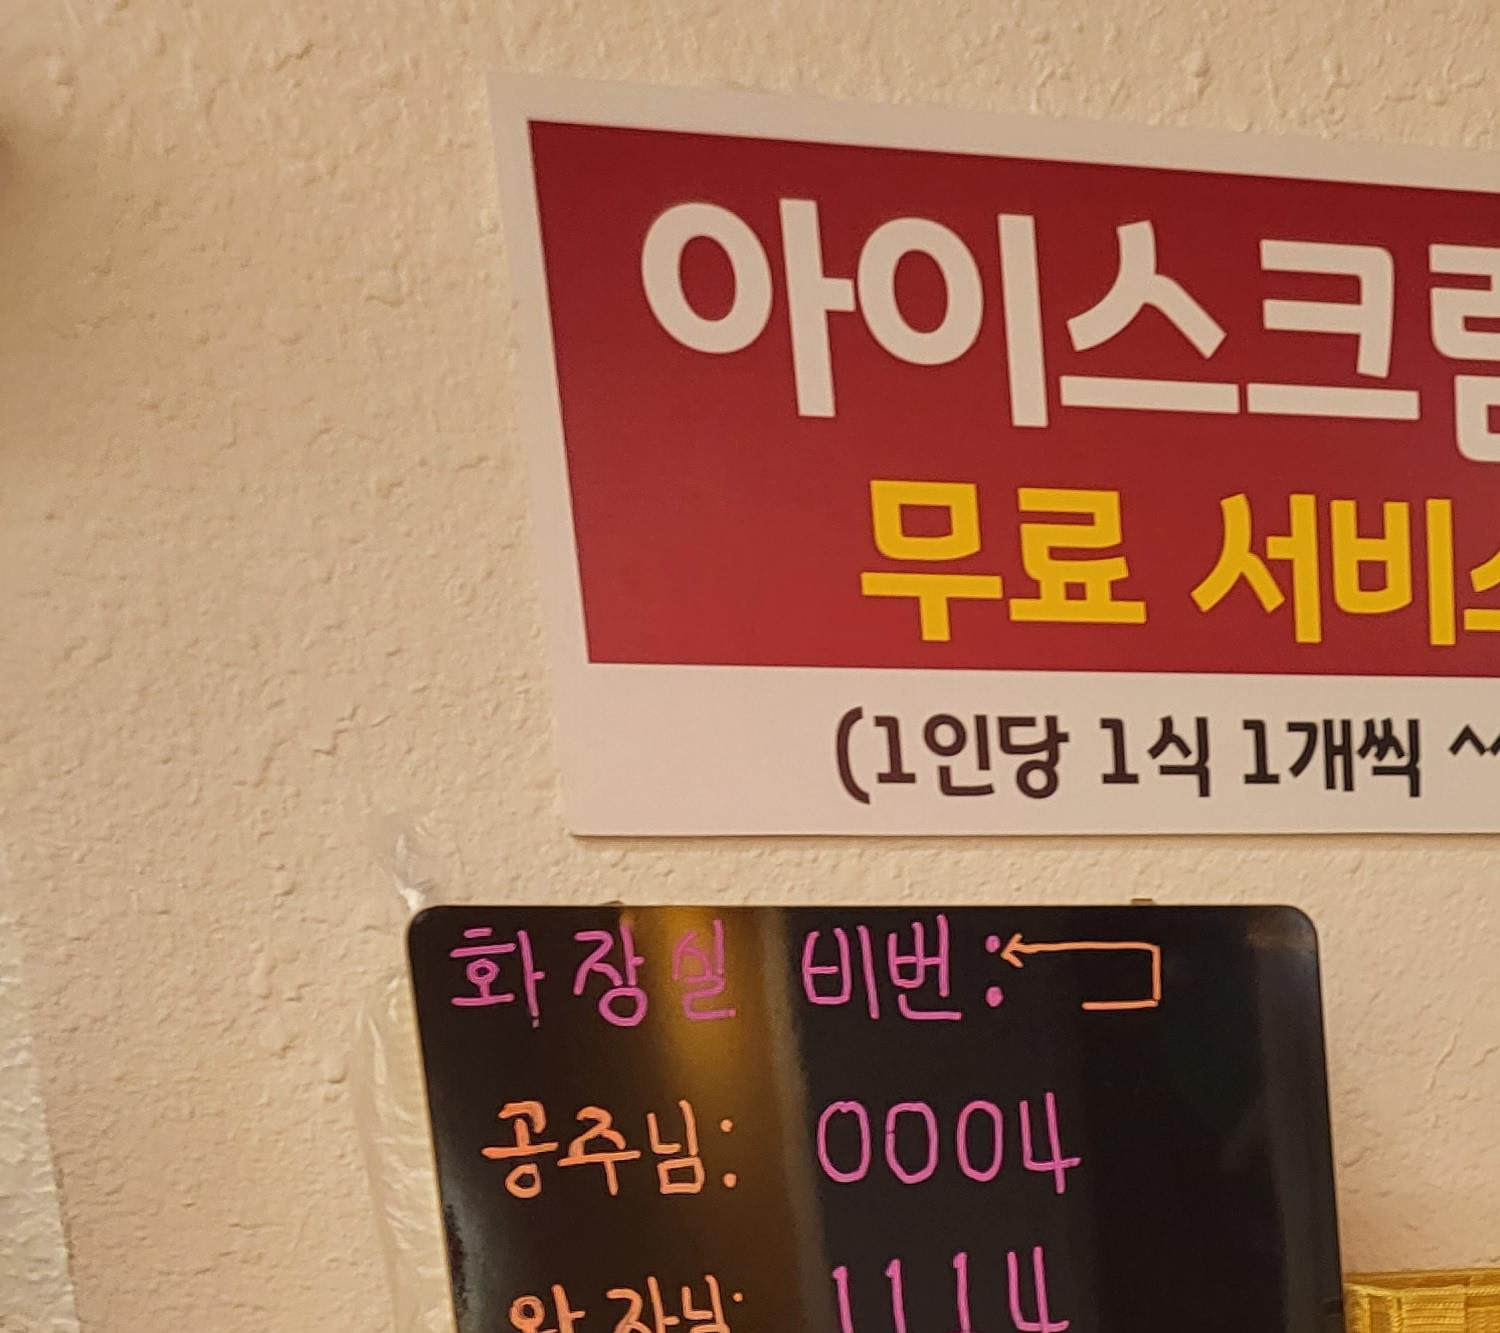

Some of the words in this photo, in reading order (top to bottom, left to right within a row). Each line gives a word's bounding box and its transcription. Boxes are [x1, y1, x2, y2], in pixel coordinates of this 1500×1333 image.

[861, 481, 1146, 641] 무료
[837, 707, 1069, 804] (1인당
[1101, 716, 1211, 798] 1식
[1243, 718, 1421, 798] 1개씩
[450, 919, 737, 1027] 화장실
[817, 1093, 1081, 1193] 0004
